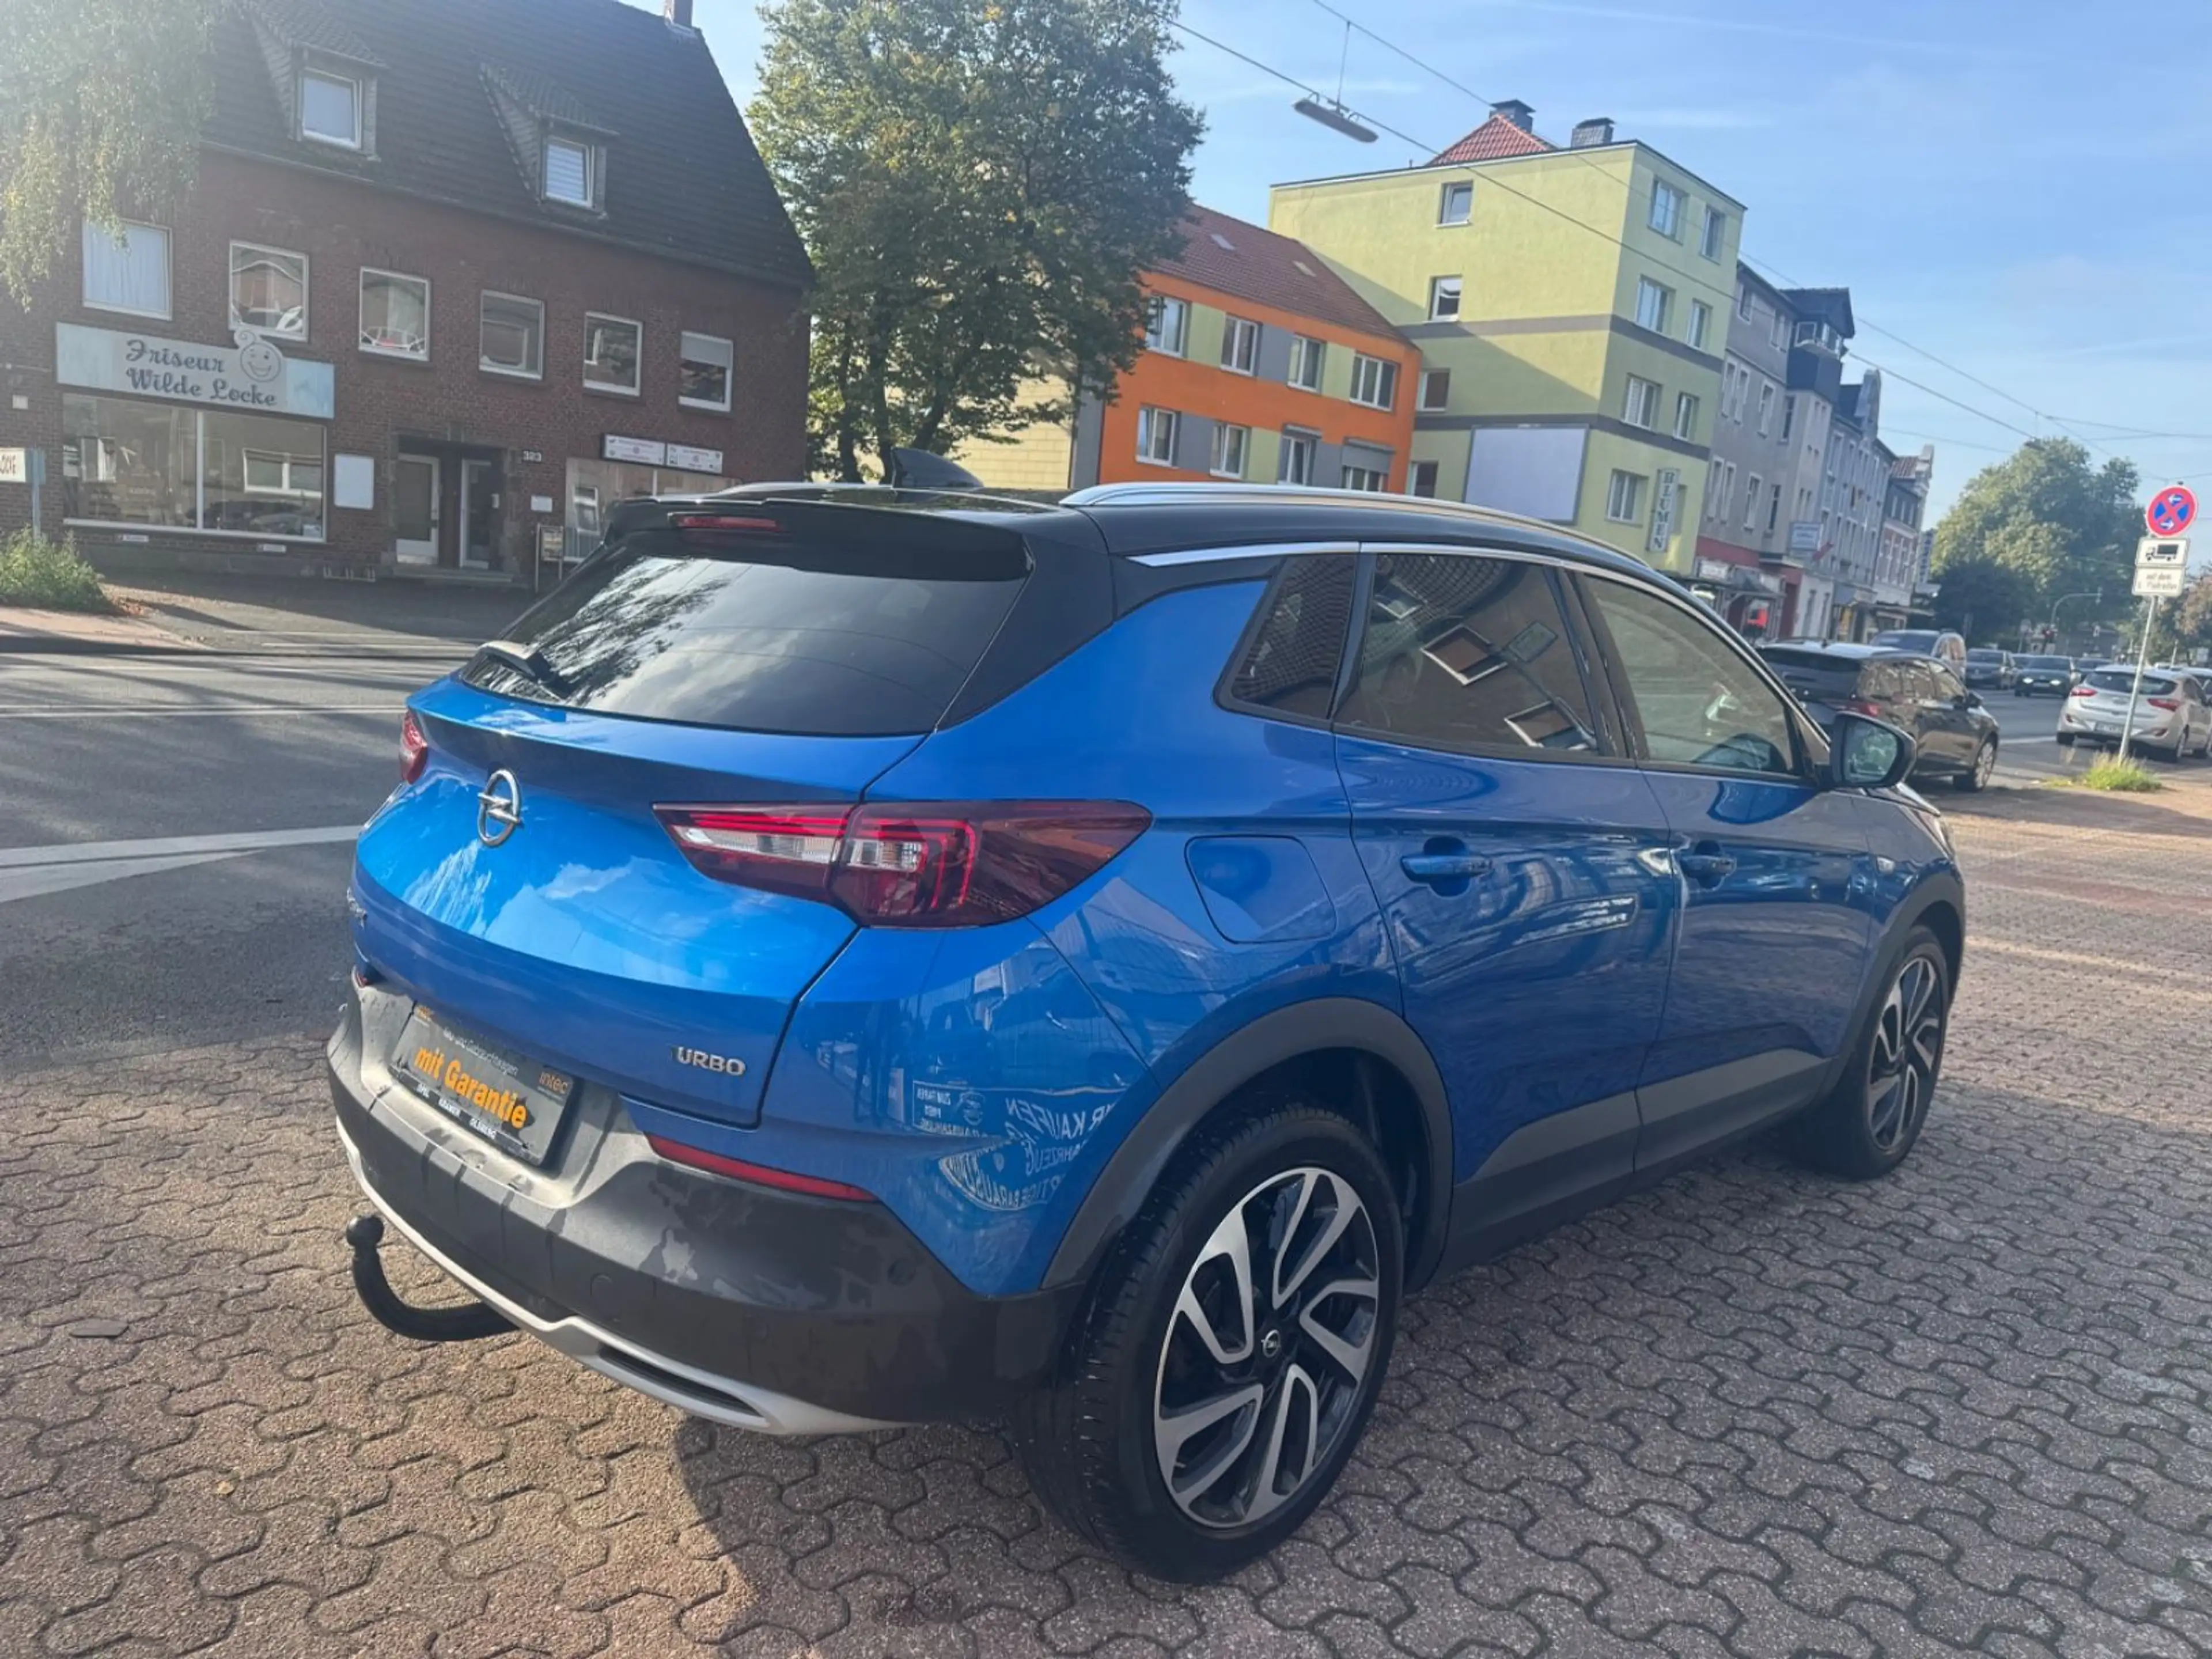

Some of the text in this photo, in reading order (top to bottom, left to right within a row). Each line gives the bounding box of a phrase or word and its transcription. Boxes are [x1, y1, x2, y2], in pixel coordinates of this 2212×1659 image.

[125, 339, 226, 373] Friseur
[124, 366, 278, 407] Wilde Locke
[1654, 471, 1675, 548] BLUMEN
[414, 1047, 445, 1081] mit
[444, 1060, 527, 1130] Garantie
